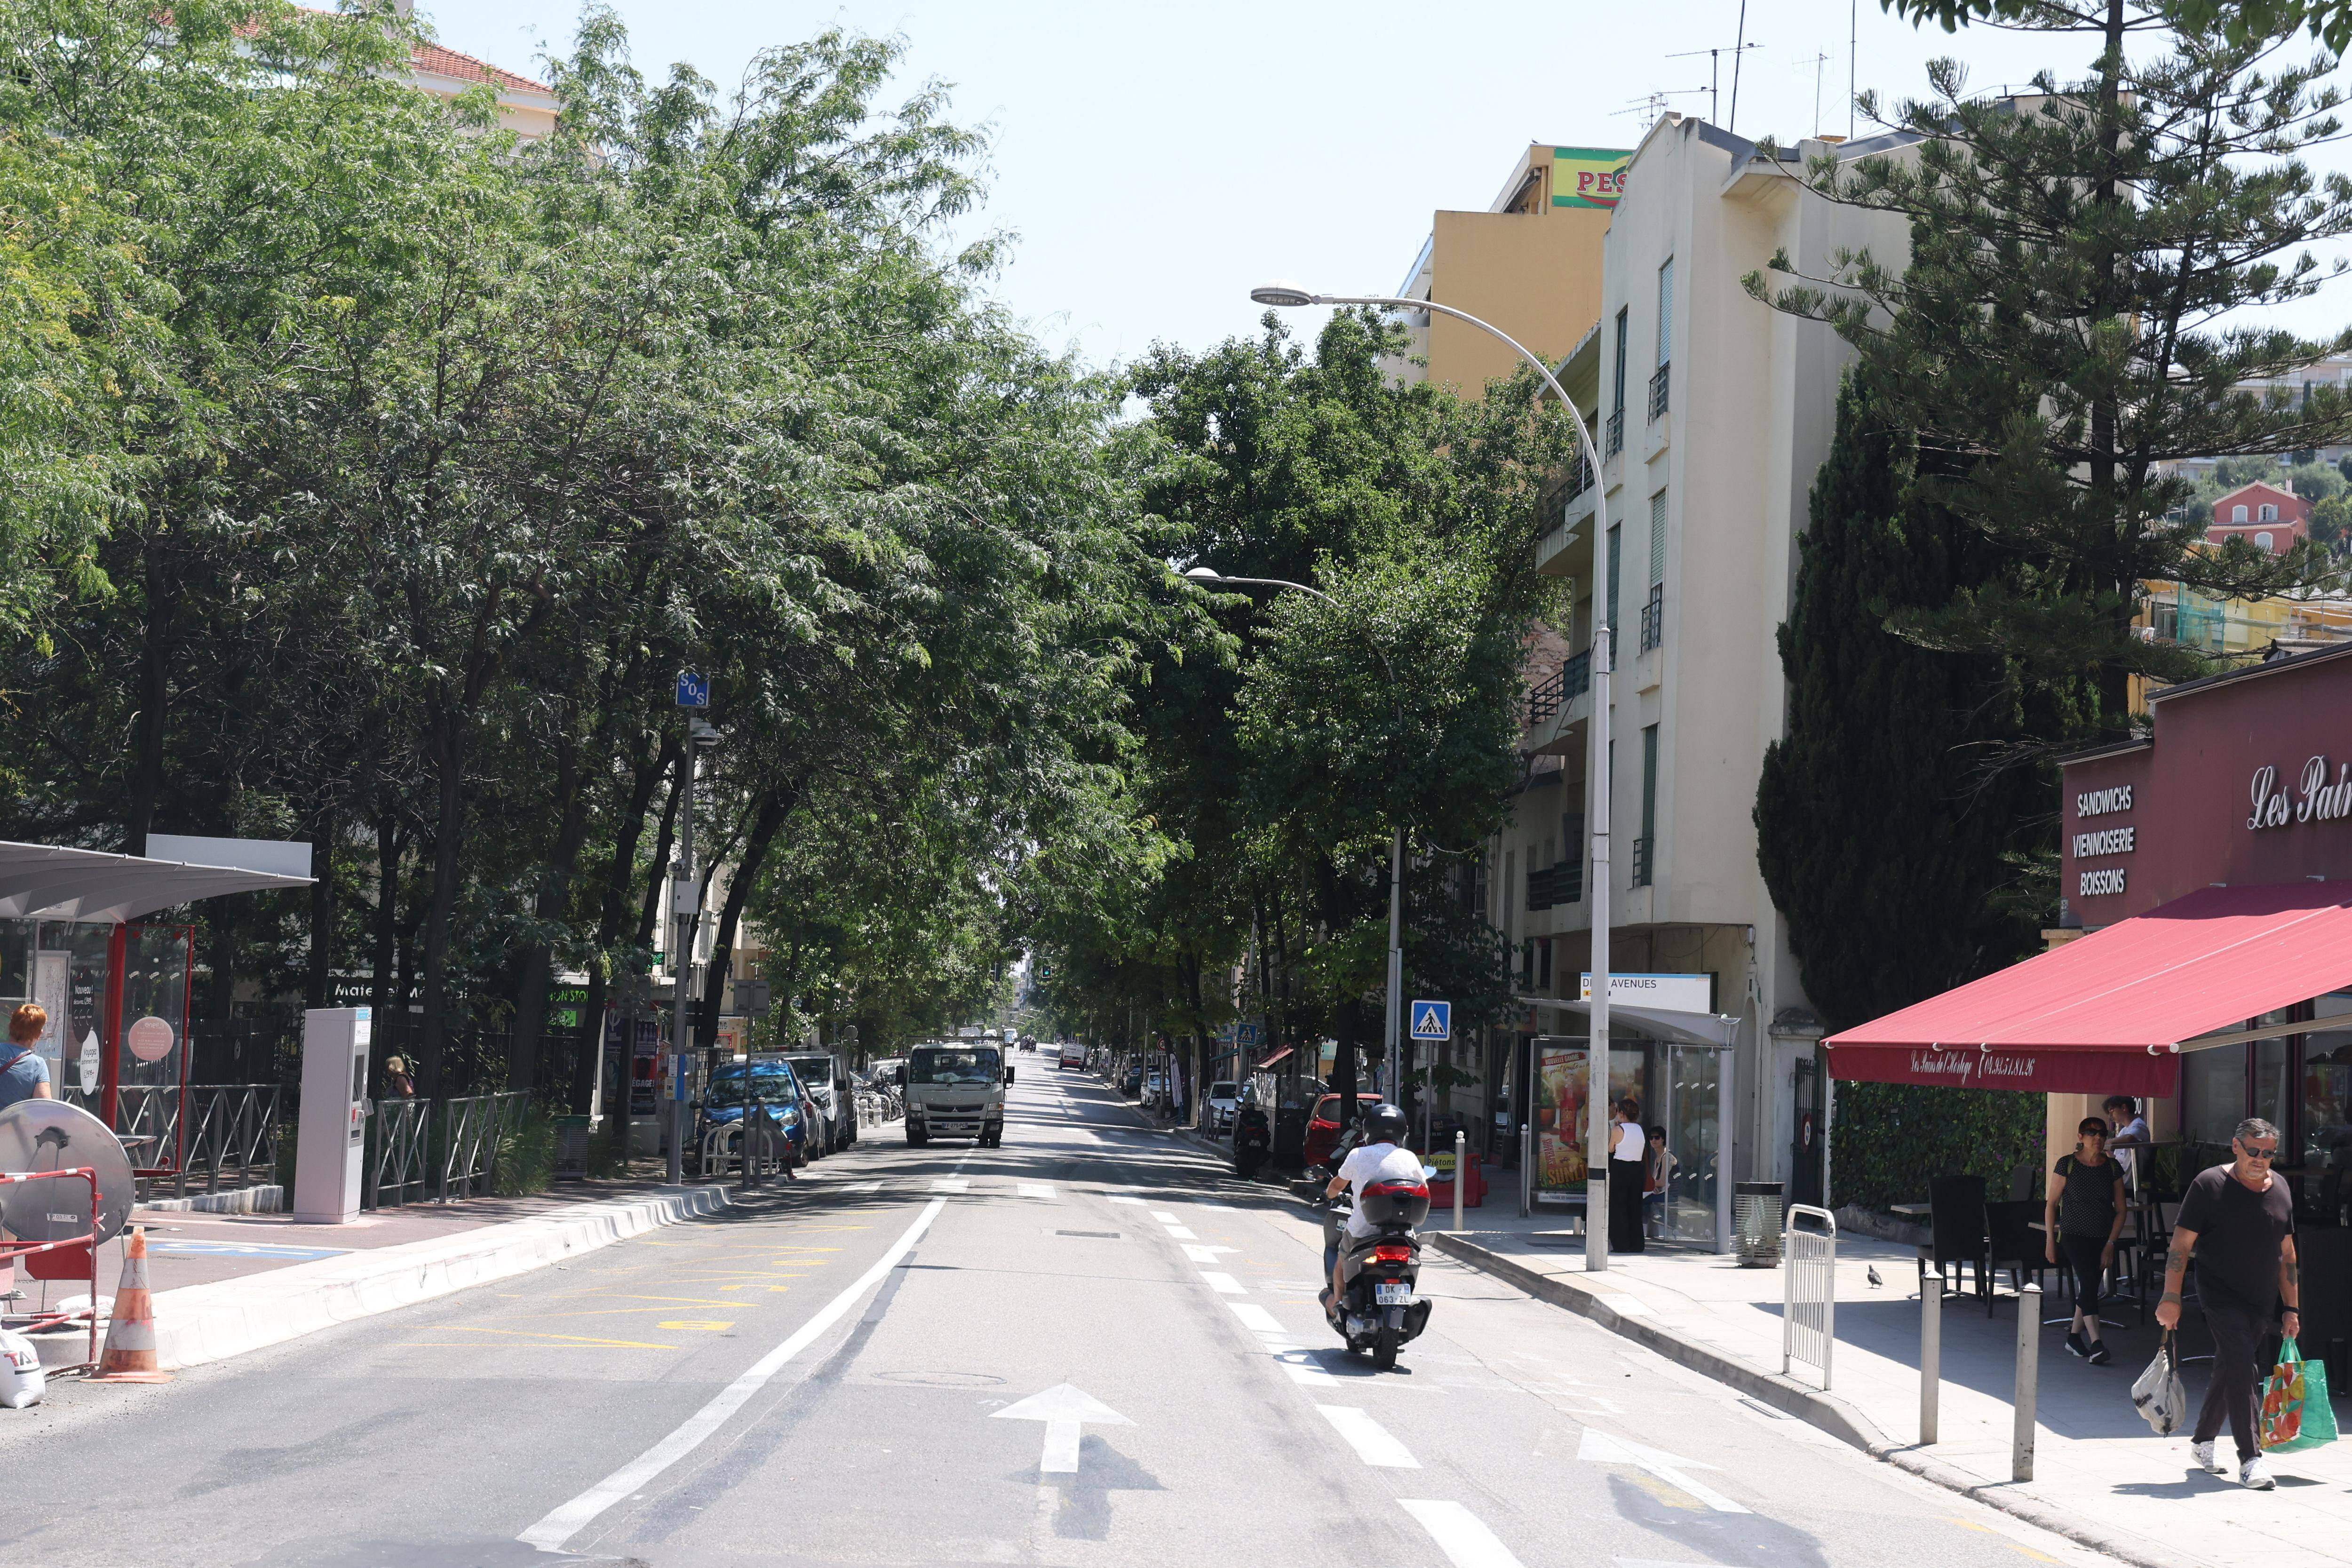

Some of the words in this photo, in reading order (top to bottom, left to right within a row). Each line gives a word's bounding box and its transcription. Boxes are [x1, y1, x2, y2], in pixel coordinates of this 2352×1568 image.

[2077, 785, 2131, 818] SANDWICHS
[2247, 765, 2291, 830] Les
[2073, 827, 2134, 858] VIENNOISERIE
[2080, 868, 2124, 896] BOISSONS
[1611, 979, 1657, 988] AVENUES
